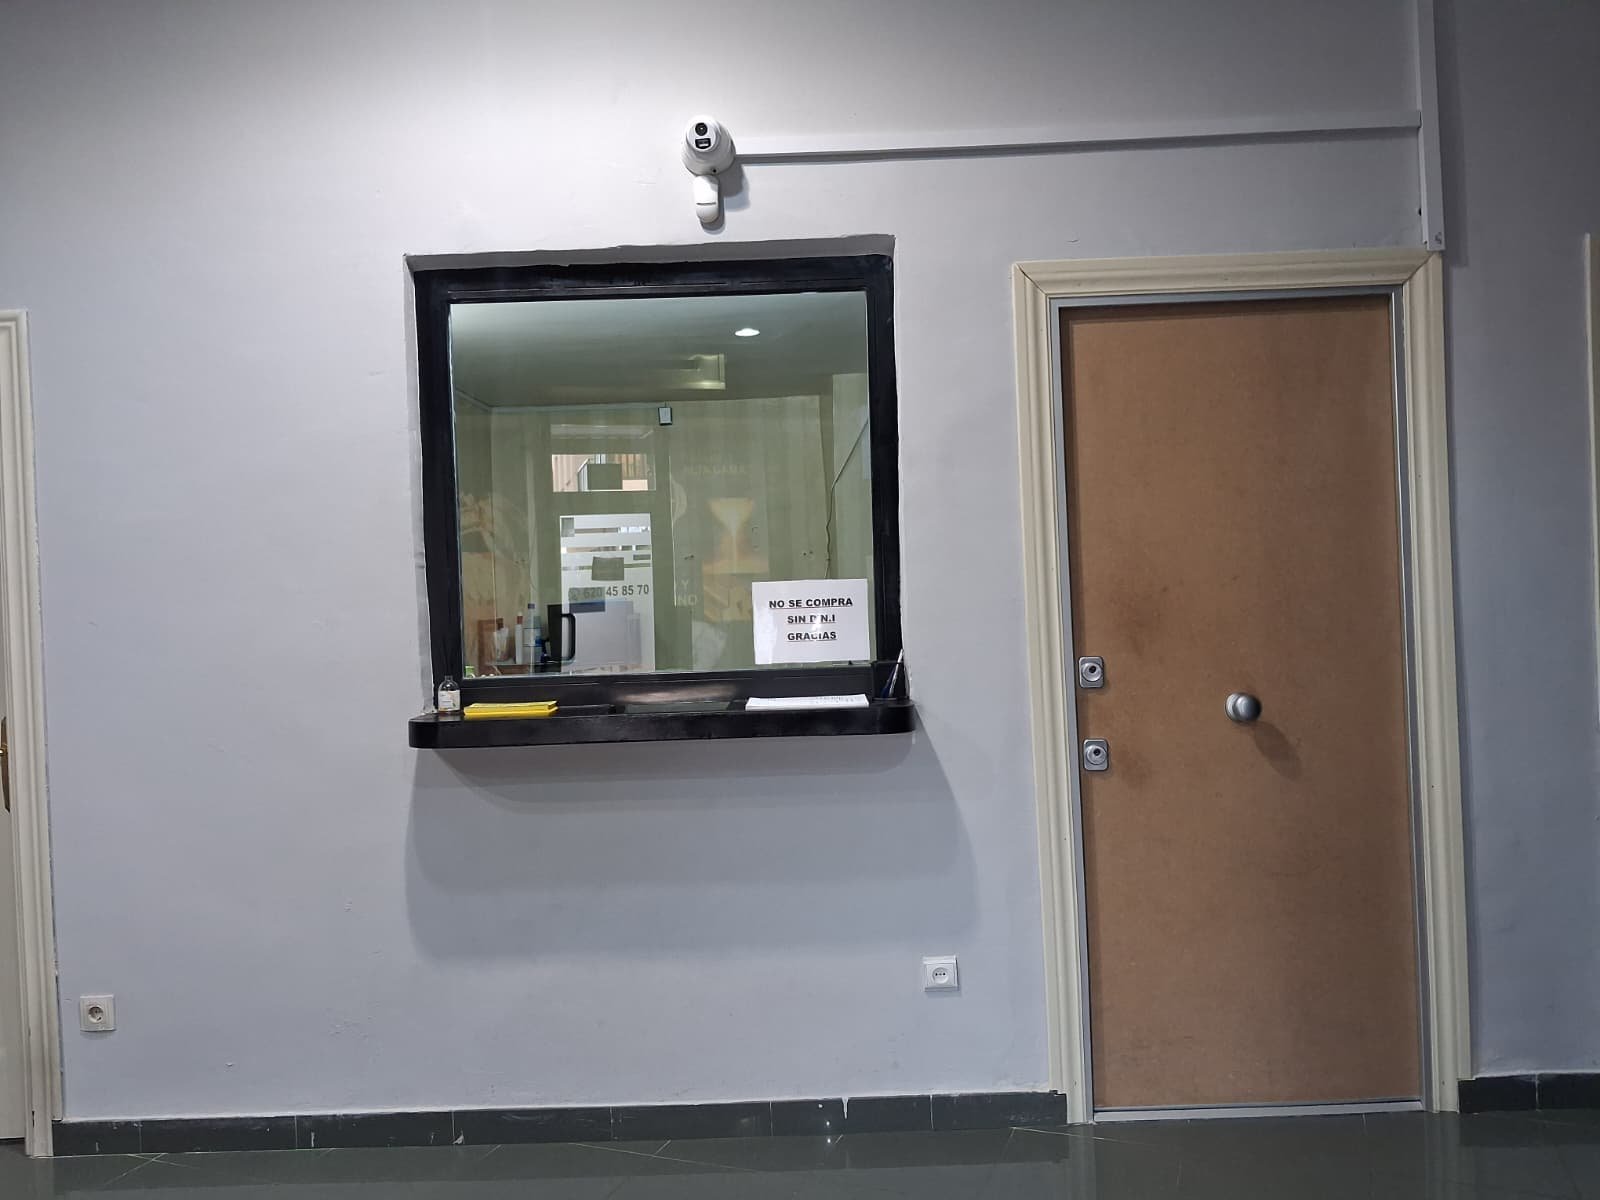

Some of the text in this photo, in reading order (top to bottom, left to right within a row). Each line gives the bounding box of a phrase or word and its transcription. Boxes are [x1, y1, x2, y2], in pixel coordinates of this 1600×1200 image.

[606, 586, 619, 597] 45
[621, 585, 634, 596] 85
[637, 584, 650, 595] 70
[768, 597, 854, 609] NO SE COMPRA
[787, 615, 806, 624] SIN
[787, 631, 837, 641] GRACIAS
